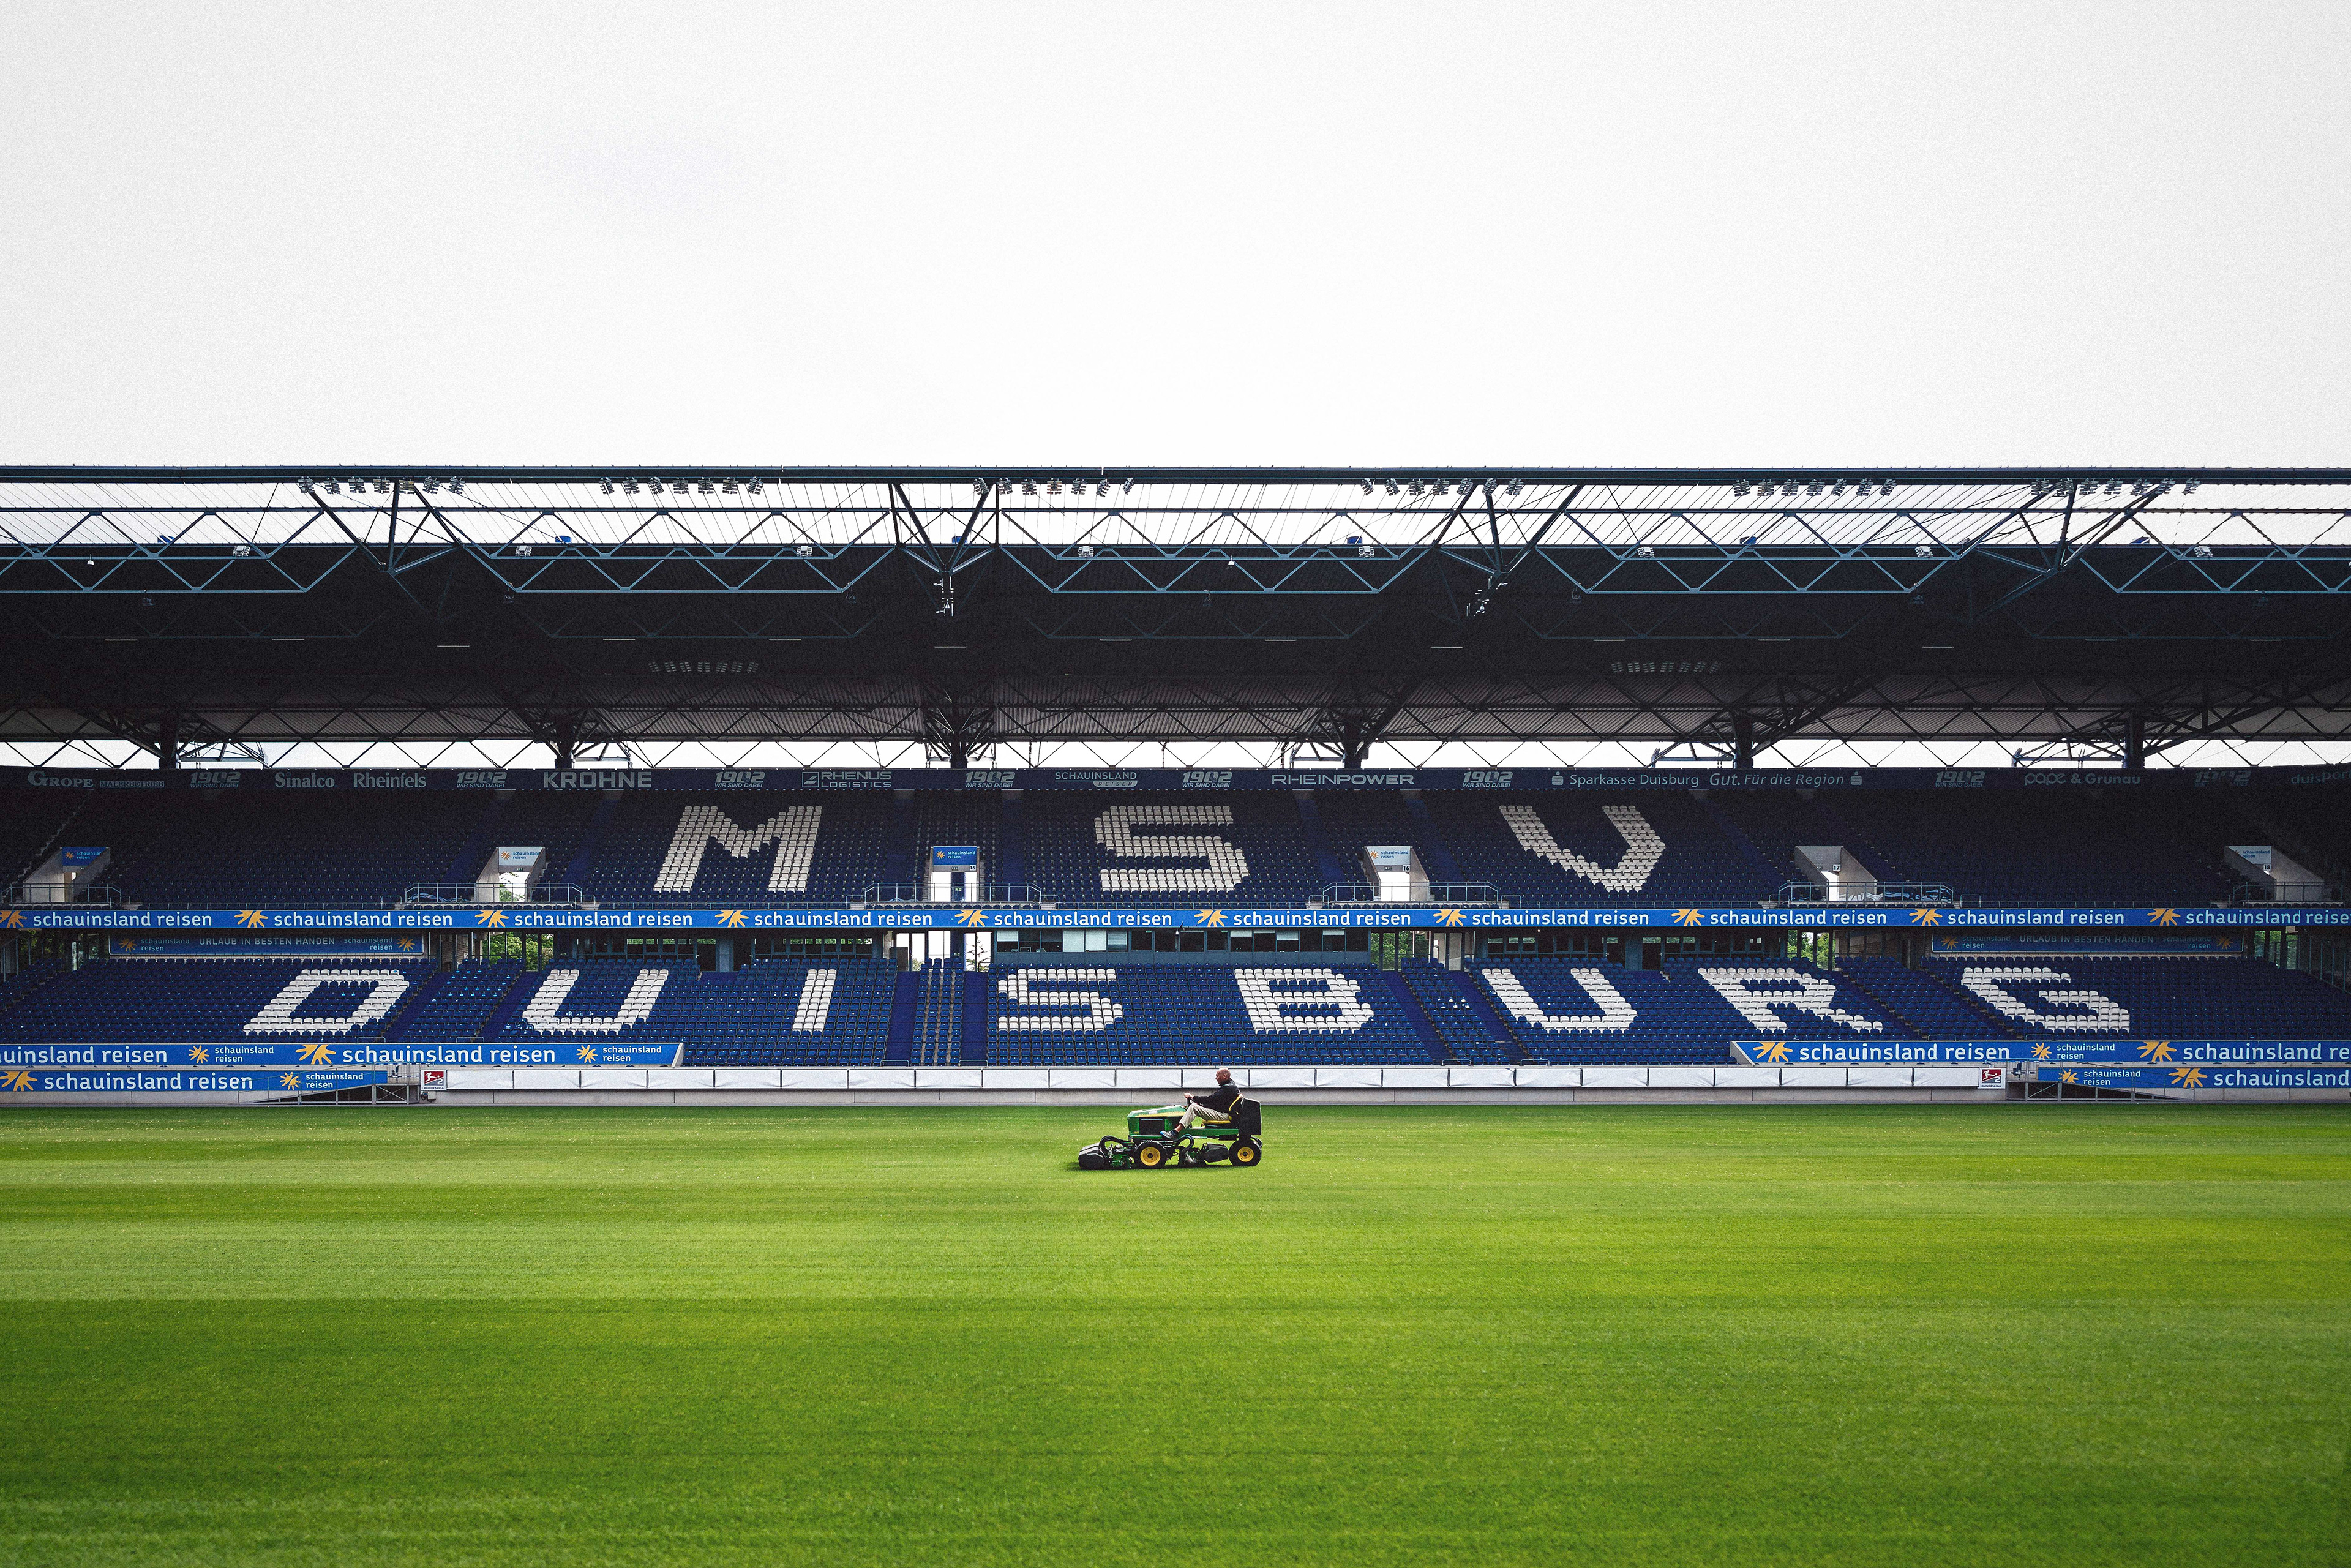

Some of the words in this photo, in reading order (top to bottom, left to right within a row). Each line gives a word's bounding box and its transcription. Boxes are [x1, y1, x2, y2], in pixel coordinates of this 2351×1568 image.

[28, 770, 94, 788] GROPE
[190, 771, 241, 784] 1902
[275, 772, 335, 788] Sinalco
[353, 772, 427, 788] Rheinfels
[456, 771, 508, 784] 1902
[543, 771, 652, 788] KROHNE
[714, 771, 766, 783] 1902
[821, 771, 892, 780] RHENUS
[965, 771, 1015, 783] 1902
[1182, 771, 1233, 783] 1902
[1272, 774, 1415, 784] RHEINPOWER
[1463, 771, 1513, 783] 1902
[1569, 773, 1635, 787] Sparkasse
[1640, 773, 1700, 787] Duisburg
[1709, 773, 1741, 786] Gut.
[1744, 774, 1767, 784] Für
[1770, 773, 1791, 784] die
[1796, 774, 1845, 787] Region
[1935, 771, 1985, 783] 1902
[2070, 773, 2082, 784] &
[33, 912, 151, 927] schauinsland
[158, 912, 212, 927] reisen
[274, 912, 391, 927] schauinsland
[398, 912, 453, 927] reisen
[515, 911, 631, 926] schauinsland
[638, 911, 692, 926] reisen
[754, 911, 871, 926] schauinsland
[877, 911, 932, 926] reisen
[994, 911, 1111, 926] schauinsland
[1117, 911, 1172, 926] reisen
[1234, 911, 1350, 926] schauinsland
[1357, 911, 1411, 926] reisen
[1472, 911, 1588, 925] schauinsland
[1595, 911, 1649, 925] reisen
[1710, 910, 1826, 925] schauinsland
[1832, 910, 1886, 925] reisen
[1948, 910, 2064, 925] schauinsland
[2070, 910, 2124, 925] reisen
[2186, 910, 2300, 925] schauinsland
[2306, 910, 2351, 925] reise
[0, 1046, 95, 1063] uinsland
[102, 1046, 167, 1063] reisen
[342, 1045, 482, 1063] schauinsland
[490, 1045, 555, 1062] reisen
[1799, 1043, 1938, 1060] schauinsland
[1945, 1043, 2009, 1060] reisen
[2183, 1043, 2321, 1060] schauinsland
[45, 1072, 181, 1089] schauinsland
[189, 1072, 252, 1089] reisen
[2214, 1069, 2350, 1086] schauinsland
